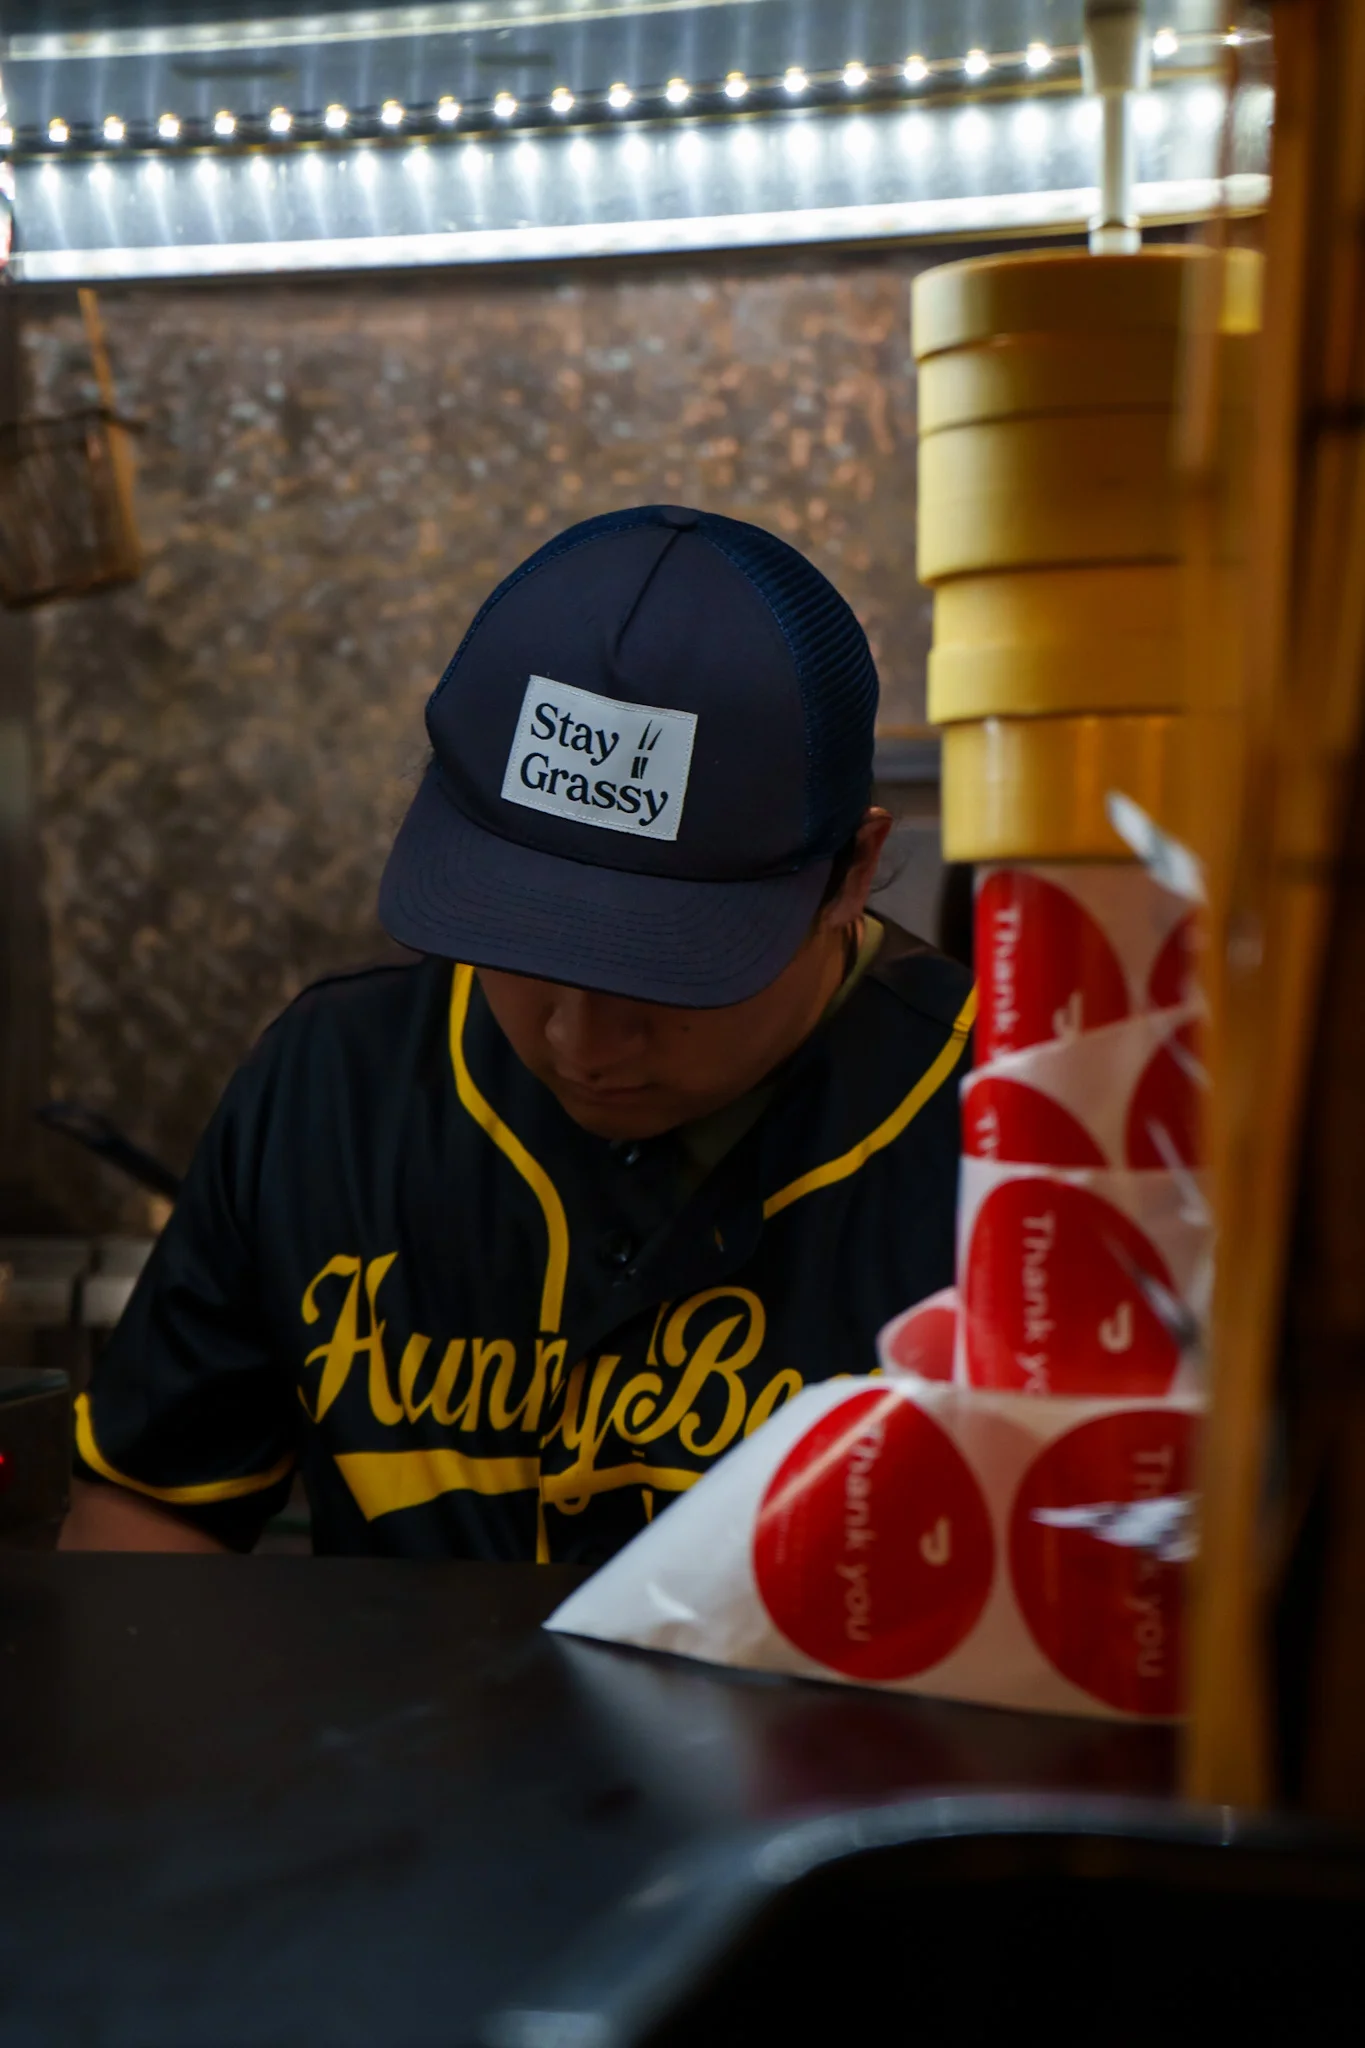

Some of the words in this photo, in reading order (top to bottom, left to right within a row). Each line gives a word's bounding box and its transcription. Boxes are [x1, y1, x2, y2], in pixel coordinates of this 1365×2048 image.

[530, 702, 620, 766] Stay
[519, 752, 669, 826] Grassy
[1021, 1209, 1058, 1345] Thank
[835, 1562, 873, 1643] you
[1123, 1592, 1166, 1678] you
